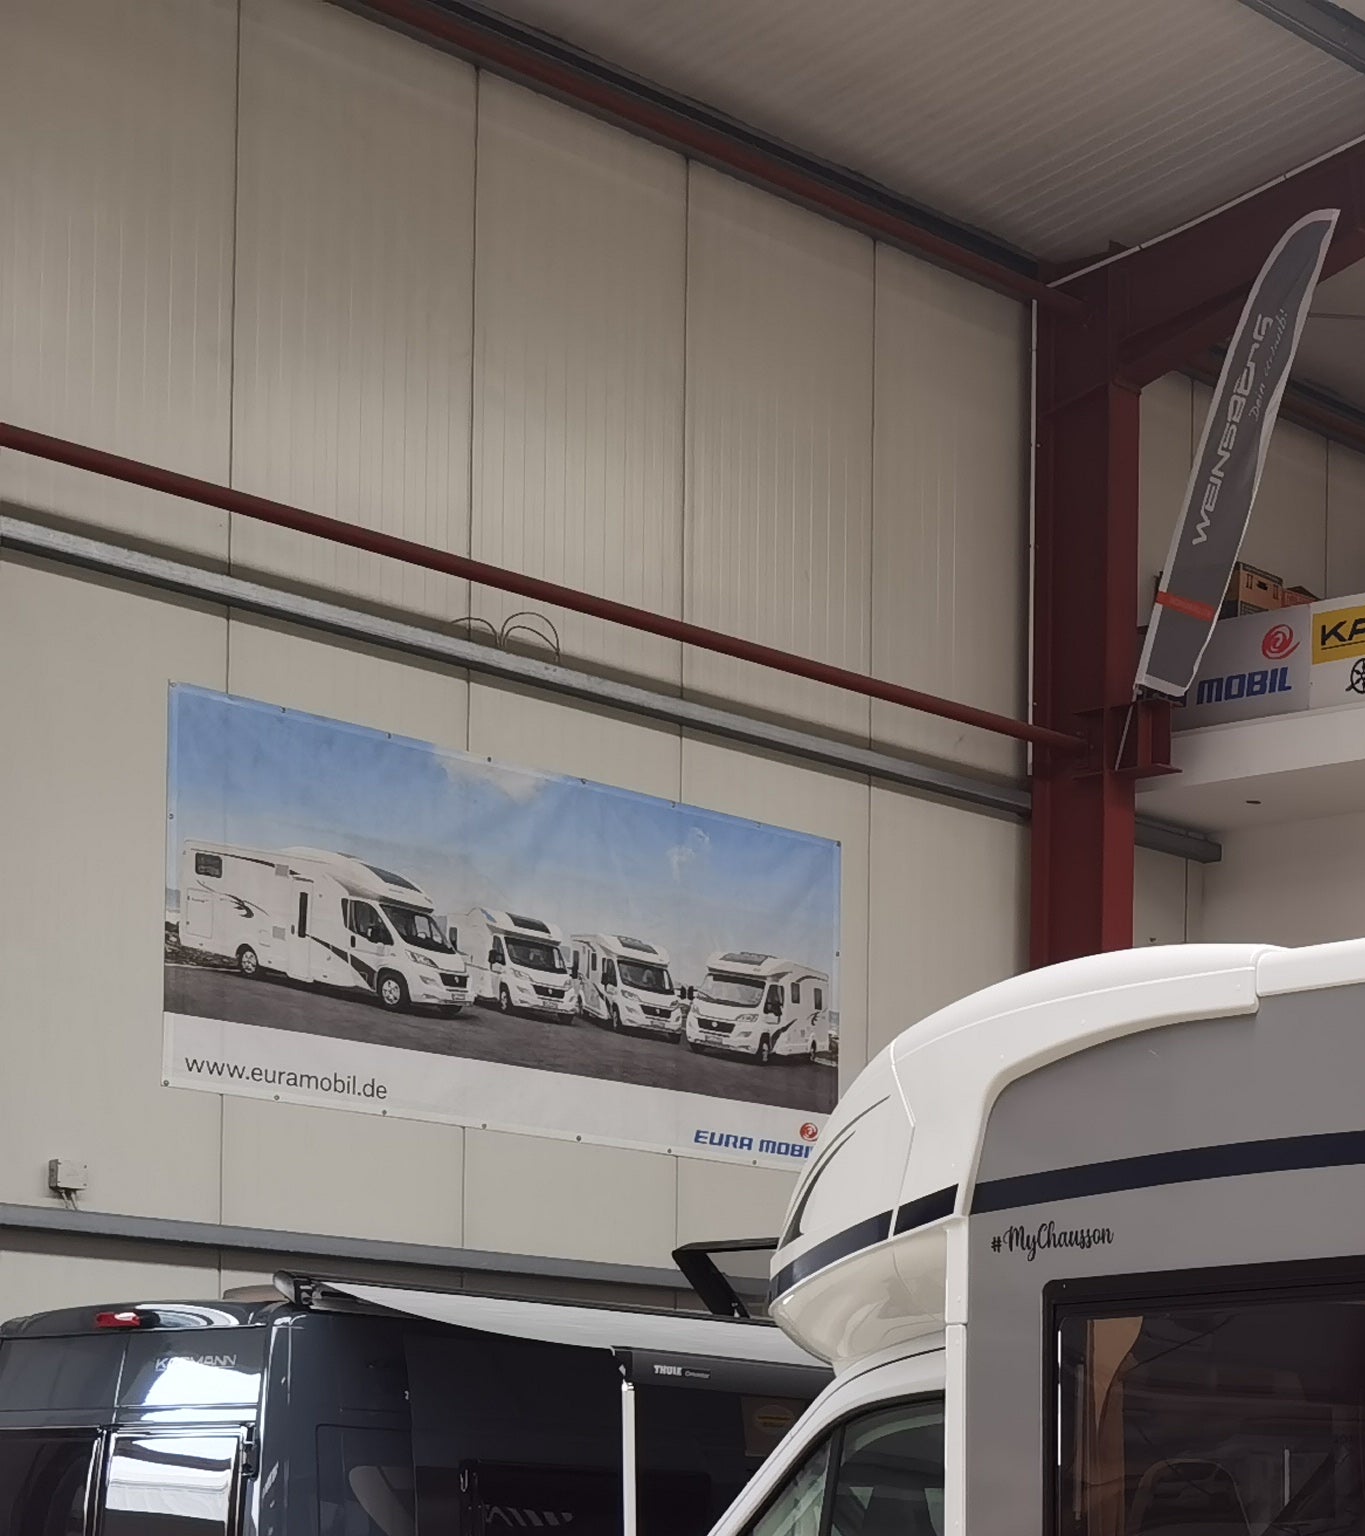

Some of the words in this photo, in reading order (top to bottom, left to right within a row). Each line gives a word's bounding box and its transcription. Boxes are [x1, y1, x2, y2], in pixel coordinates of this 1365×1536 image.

[1196, 666, 1292, 705] MOBIL
[184, 1056, 388, 1099] www.euramobil.de
[694, 1129, 753, 1151] EURA
[759, 1139, 813, 1158] MOBI
[990, 1220, 1114, 1262] #MyChausson
[653, 1365, 682, 1376] THULE
